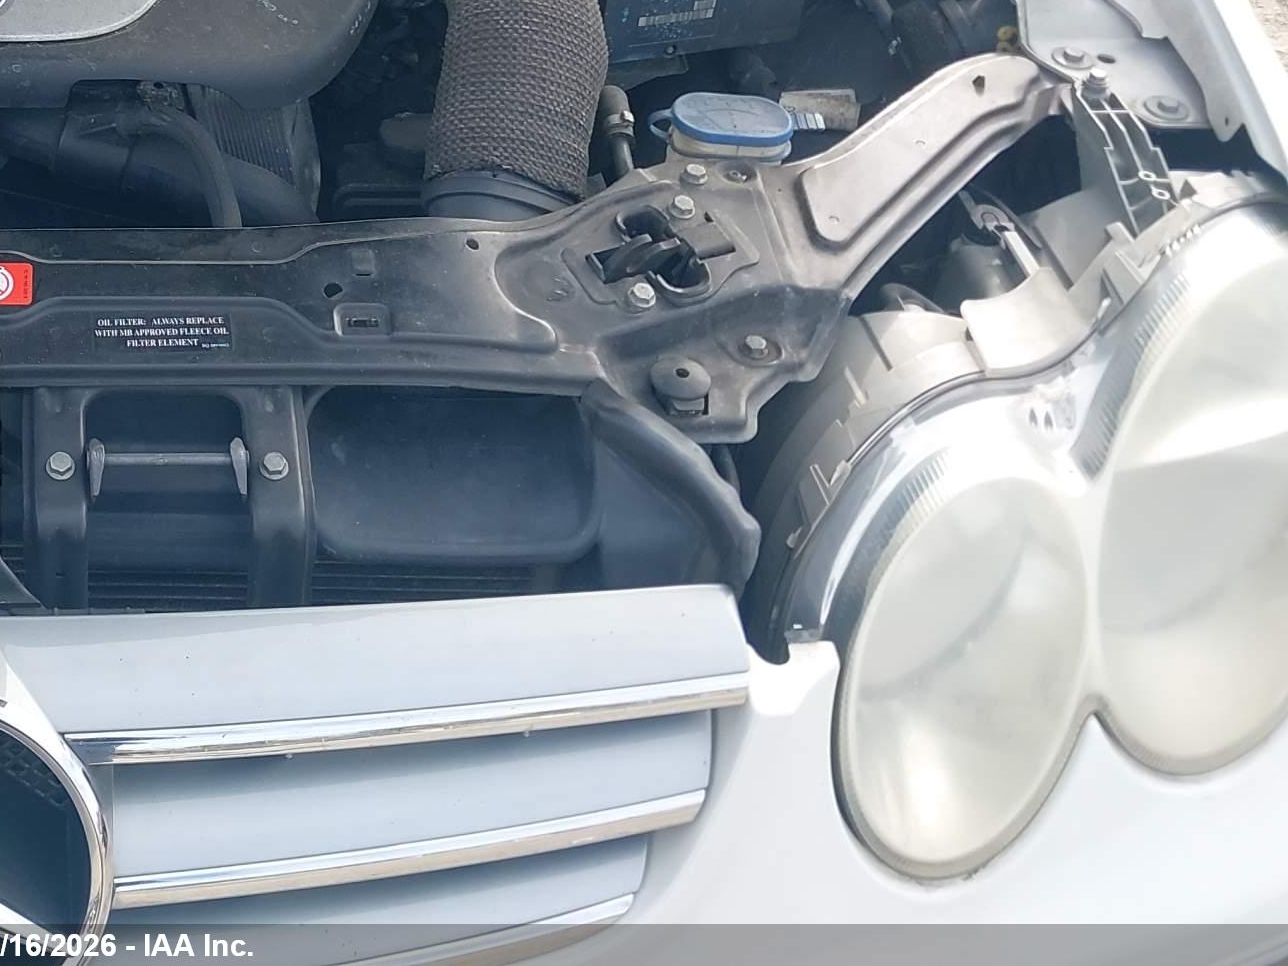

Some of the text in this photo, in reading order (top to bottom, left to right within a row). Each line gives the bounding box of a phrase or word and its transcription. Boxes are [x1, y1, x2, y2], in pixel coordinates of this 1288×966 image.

[97, 316, 224, 327] OIL FILTER: ALWAYS REPLACE
[95, 327, 229, 337] WITH MB APPROVED FLEECE OIL
[127, 339, 157, 347] FILTER
[158, 338, 199, 346] ELEMENT
